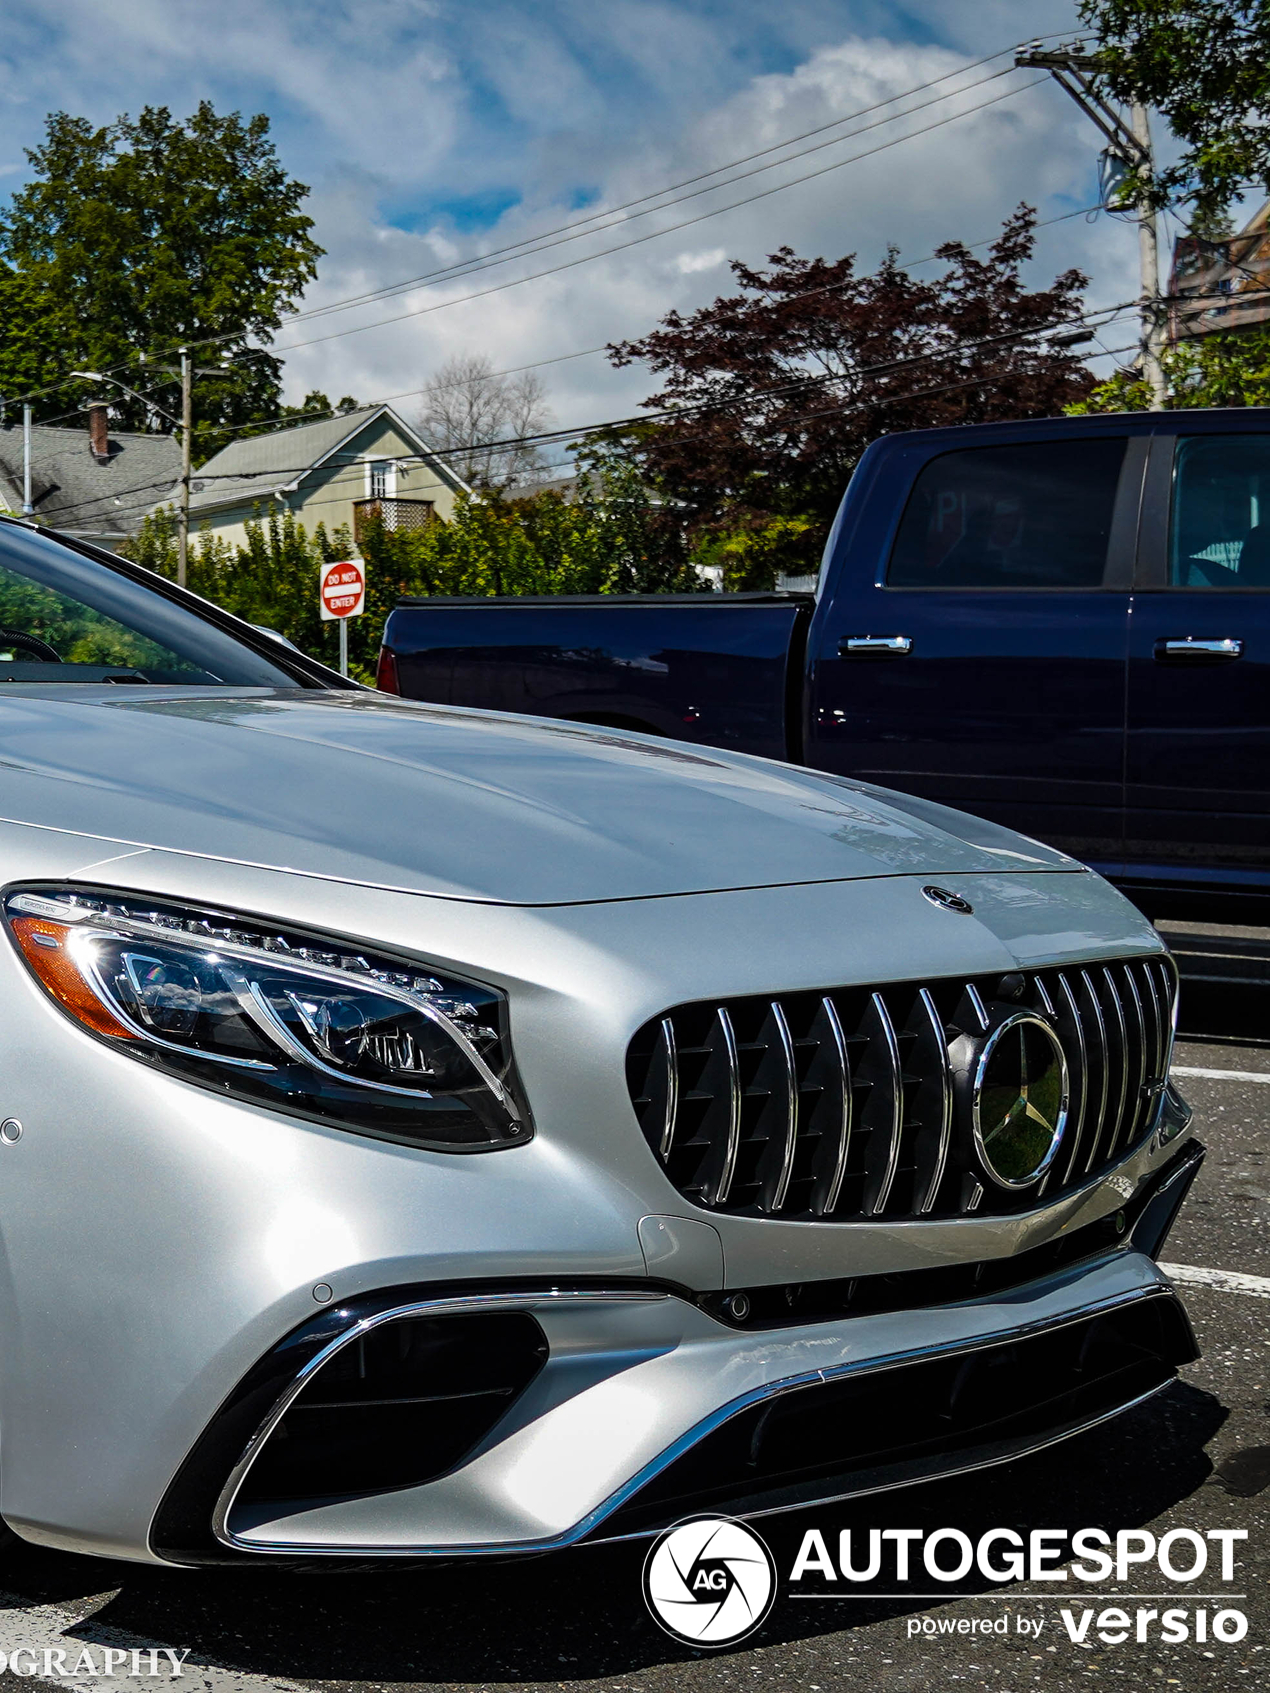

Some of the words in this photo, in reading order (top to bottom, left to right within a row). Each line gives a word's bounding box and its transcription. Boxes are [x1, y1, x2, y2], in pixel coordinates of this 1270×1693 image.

[327, 573, 340, 586] DO
[341, 571, 358, 583] NOT
[330, 596, 356, 609] ENTER
